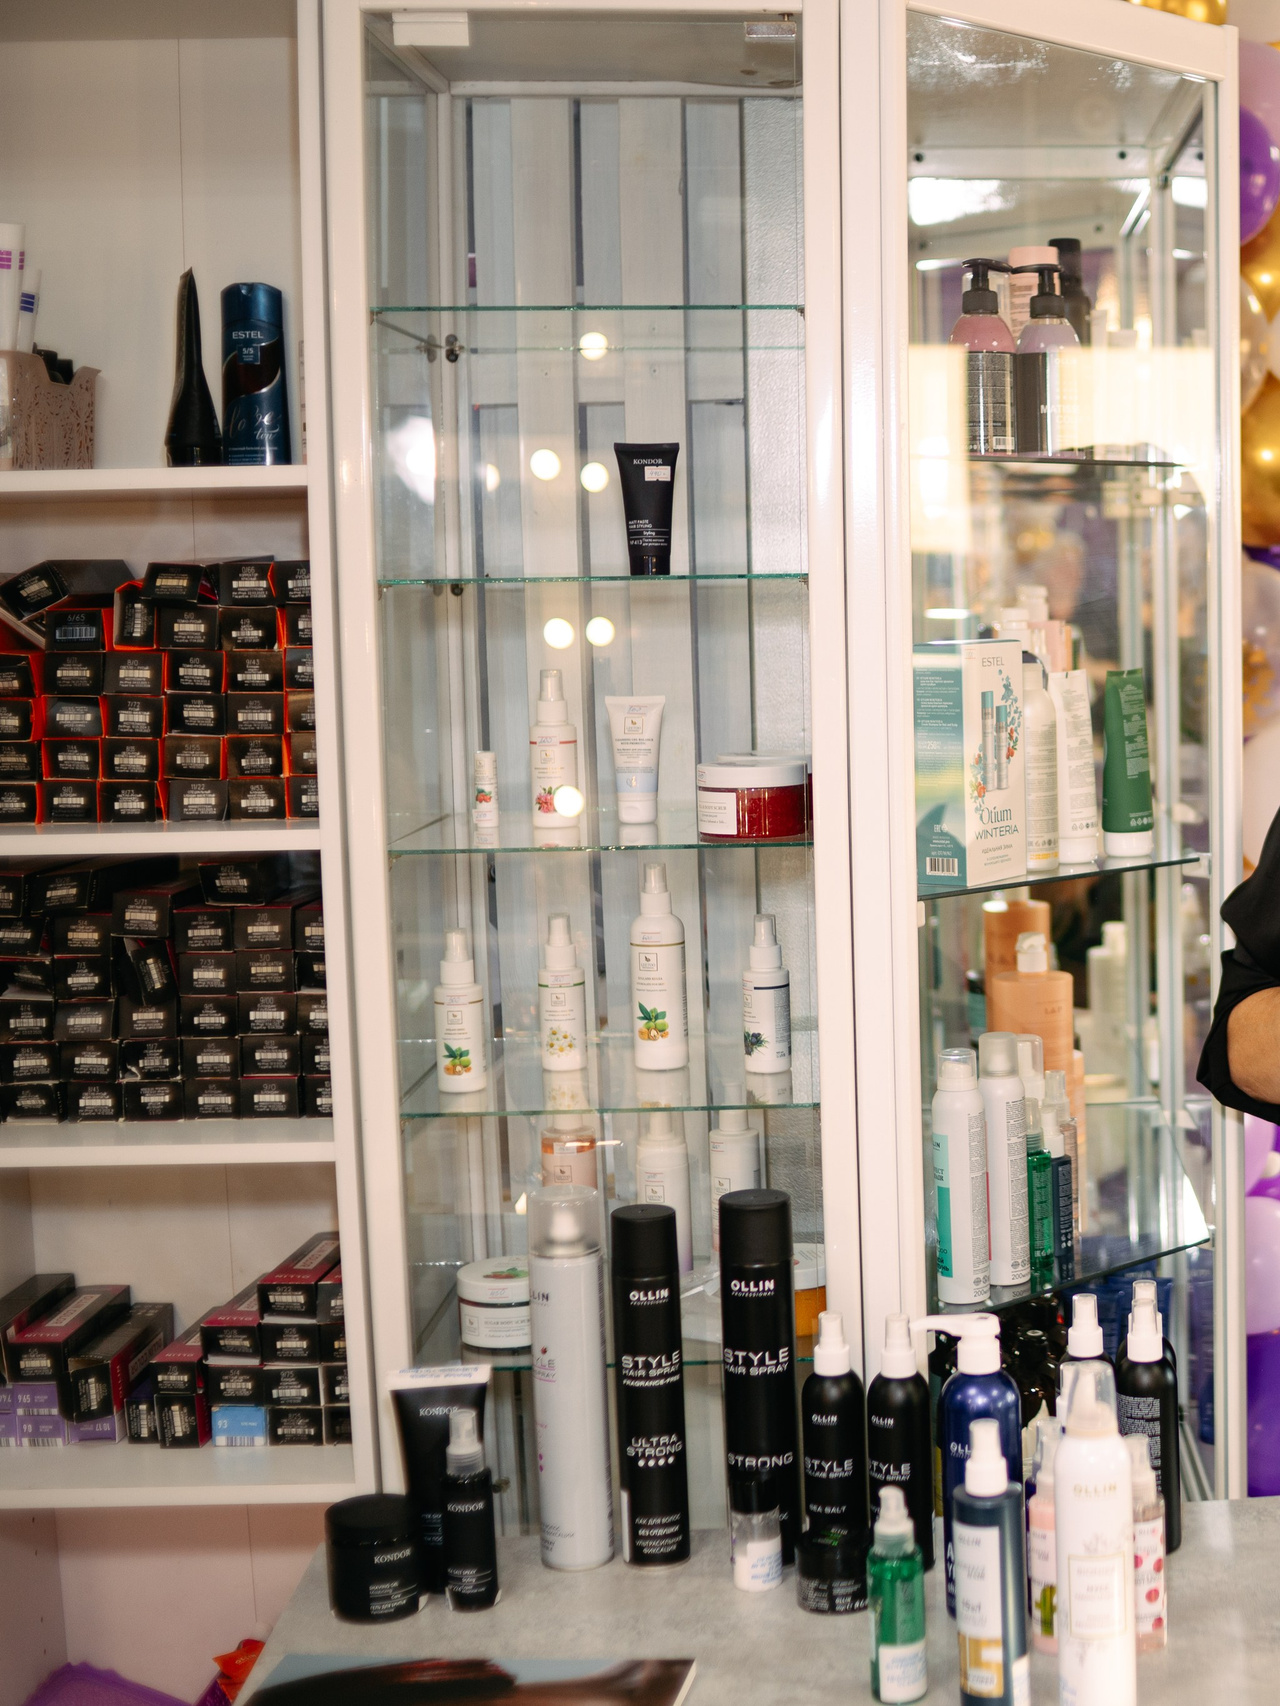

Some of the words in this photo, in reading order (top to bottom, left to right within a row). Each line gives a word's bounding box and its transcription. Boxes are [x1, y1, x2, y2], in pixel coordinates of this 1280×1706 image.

[232, 331, 264, 339] ESTEL
[242, 347, 254, 355] 5/5
[184, 612, 195, 620] 6/0
[981, 656, 1005, 667] ESTEL
[62, 786, 73, 794] 9/0
[980, 806, 1012, 825] Otium
[975, 824, 1019, 840] WINTERIA
[262, 1083, 277, 1091] 9/0
[730, 1279, 775, 1292] OLLIN
[629, 1287, 669, 1301] OLLIN
[621, 1349, 681, 1369] STYLE
[724, 1346, 789, 1366] STYLE
[622, 1369, 646, 1377] HAIR
[648, 1364, 680, 1377] SPRAY
[724, 1364, 746, 1375] HAIR
[749, 1362, 789, 1376] SPRAY
[622, 1373, 681, 1387] FRAGRANCE-FREE
[811, 1413, 838, 1423] OLLIN
[871, 1414, 894, 1426] OLLIN
[631, 1432, 678, 1448] ULTRA
[626, 1442, 683, 1458] STRONG
[727, 1451, 794, 1471] STRONG
[804, 1456, 854, 1473] STYLE
[1073, 1482, 1118, 1494] OLLIN
[447, 1501, 485, 1513] KONDOR
[824, 1505, 847, 1514] SALT
[374, 1547, 412, 1564] KONDOR
